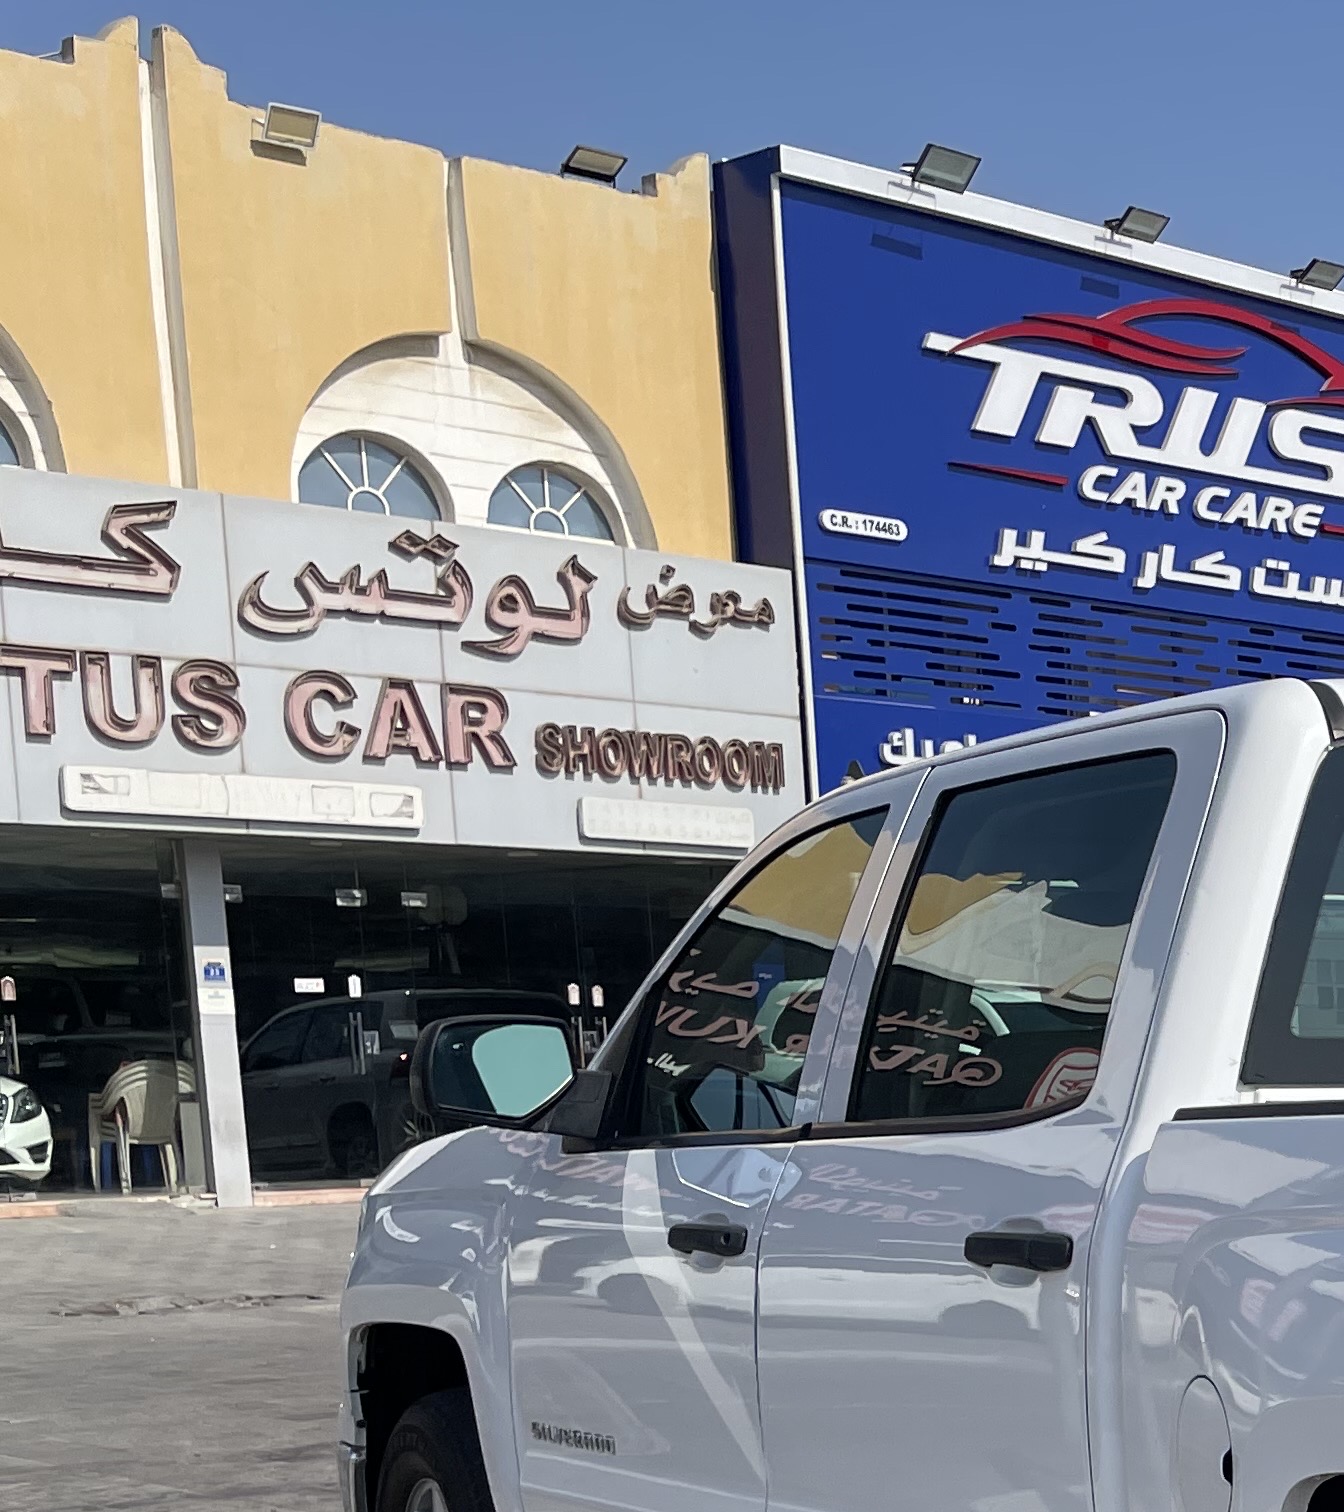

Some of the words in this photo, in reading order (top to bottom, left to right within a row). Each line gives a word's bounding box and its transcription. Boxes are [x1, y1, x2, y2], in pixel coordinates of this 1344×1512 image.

[862, 518, 901, 536] 174463
[1078, 466, 1187, 515] CAR
[1193, 485, 1325, 538] CARE
[991, 527, 1126, 574] كير
[1133, 543, 1242, 591] كار
[238, 528, 599, 661] لوتس
[616, 565, 775, 637] معرض
[0, 643, 247, 749] TUS
[284, 669, 516, 770] CAR
[535, 721, 785, 792] SHOWROOM
